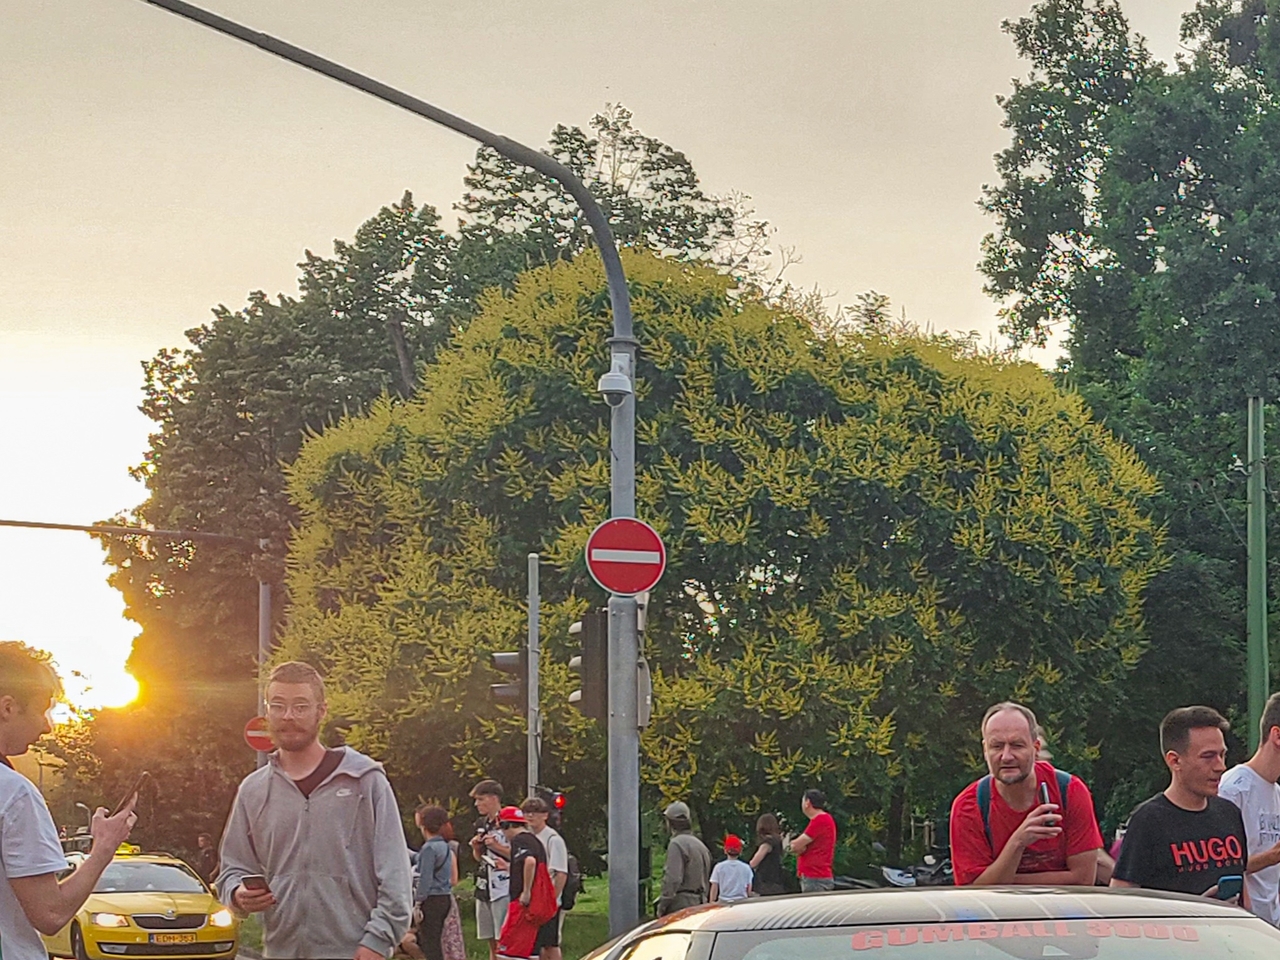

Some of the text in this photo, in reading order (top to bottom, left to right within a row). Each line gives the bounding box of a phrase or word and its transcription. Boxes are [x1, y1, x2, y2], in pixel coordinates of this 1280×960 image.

[1170, 835, 1242, 866] HUGO
[851, 920, 1200, 950] GUMBALL 3000
